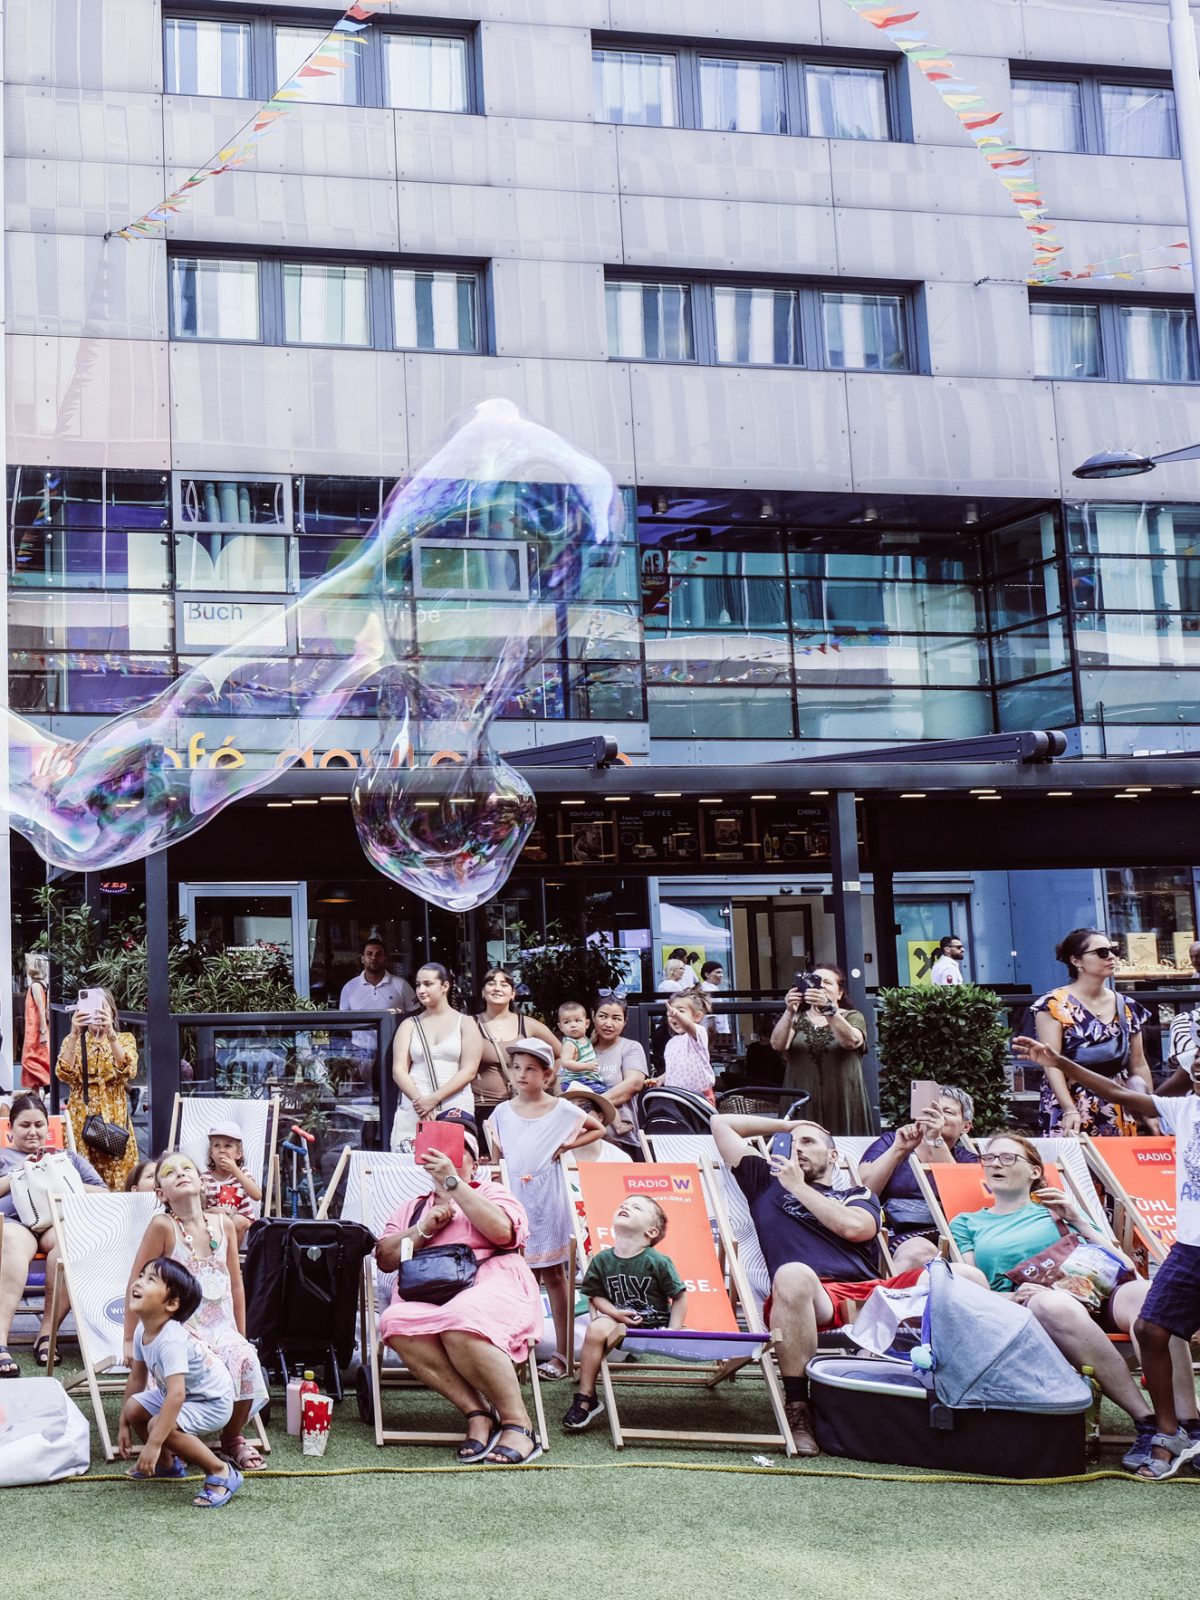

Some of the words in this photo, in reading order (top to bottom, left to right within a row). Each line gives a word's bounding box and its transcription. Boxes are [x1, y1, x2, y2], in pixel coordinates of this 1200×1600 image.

[188, 602, 243, 620] Buch
[1137, 1152, 1172, 1162] RADIO
[627, 1179, 669, 1189] RADIO
[673, 1178, 690, 1190] W
[1136, 1197, 1175, 1212] ÜHL
[606, 1274, 652, 1305] FLY
[684, 1279, 717, 1293] SE.
